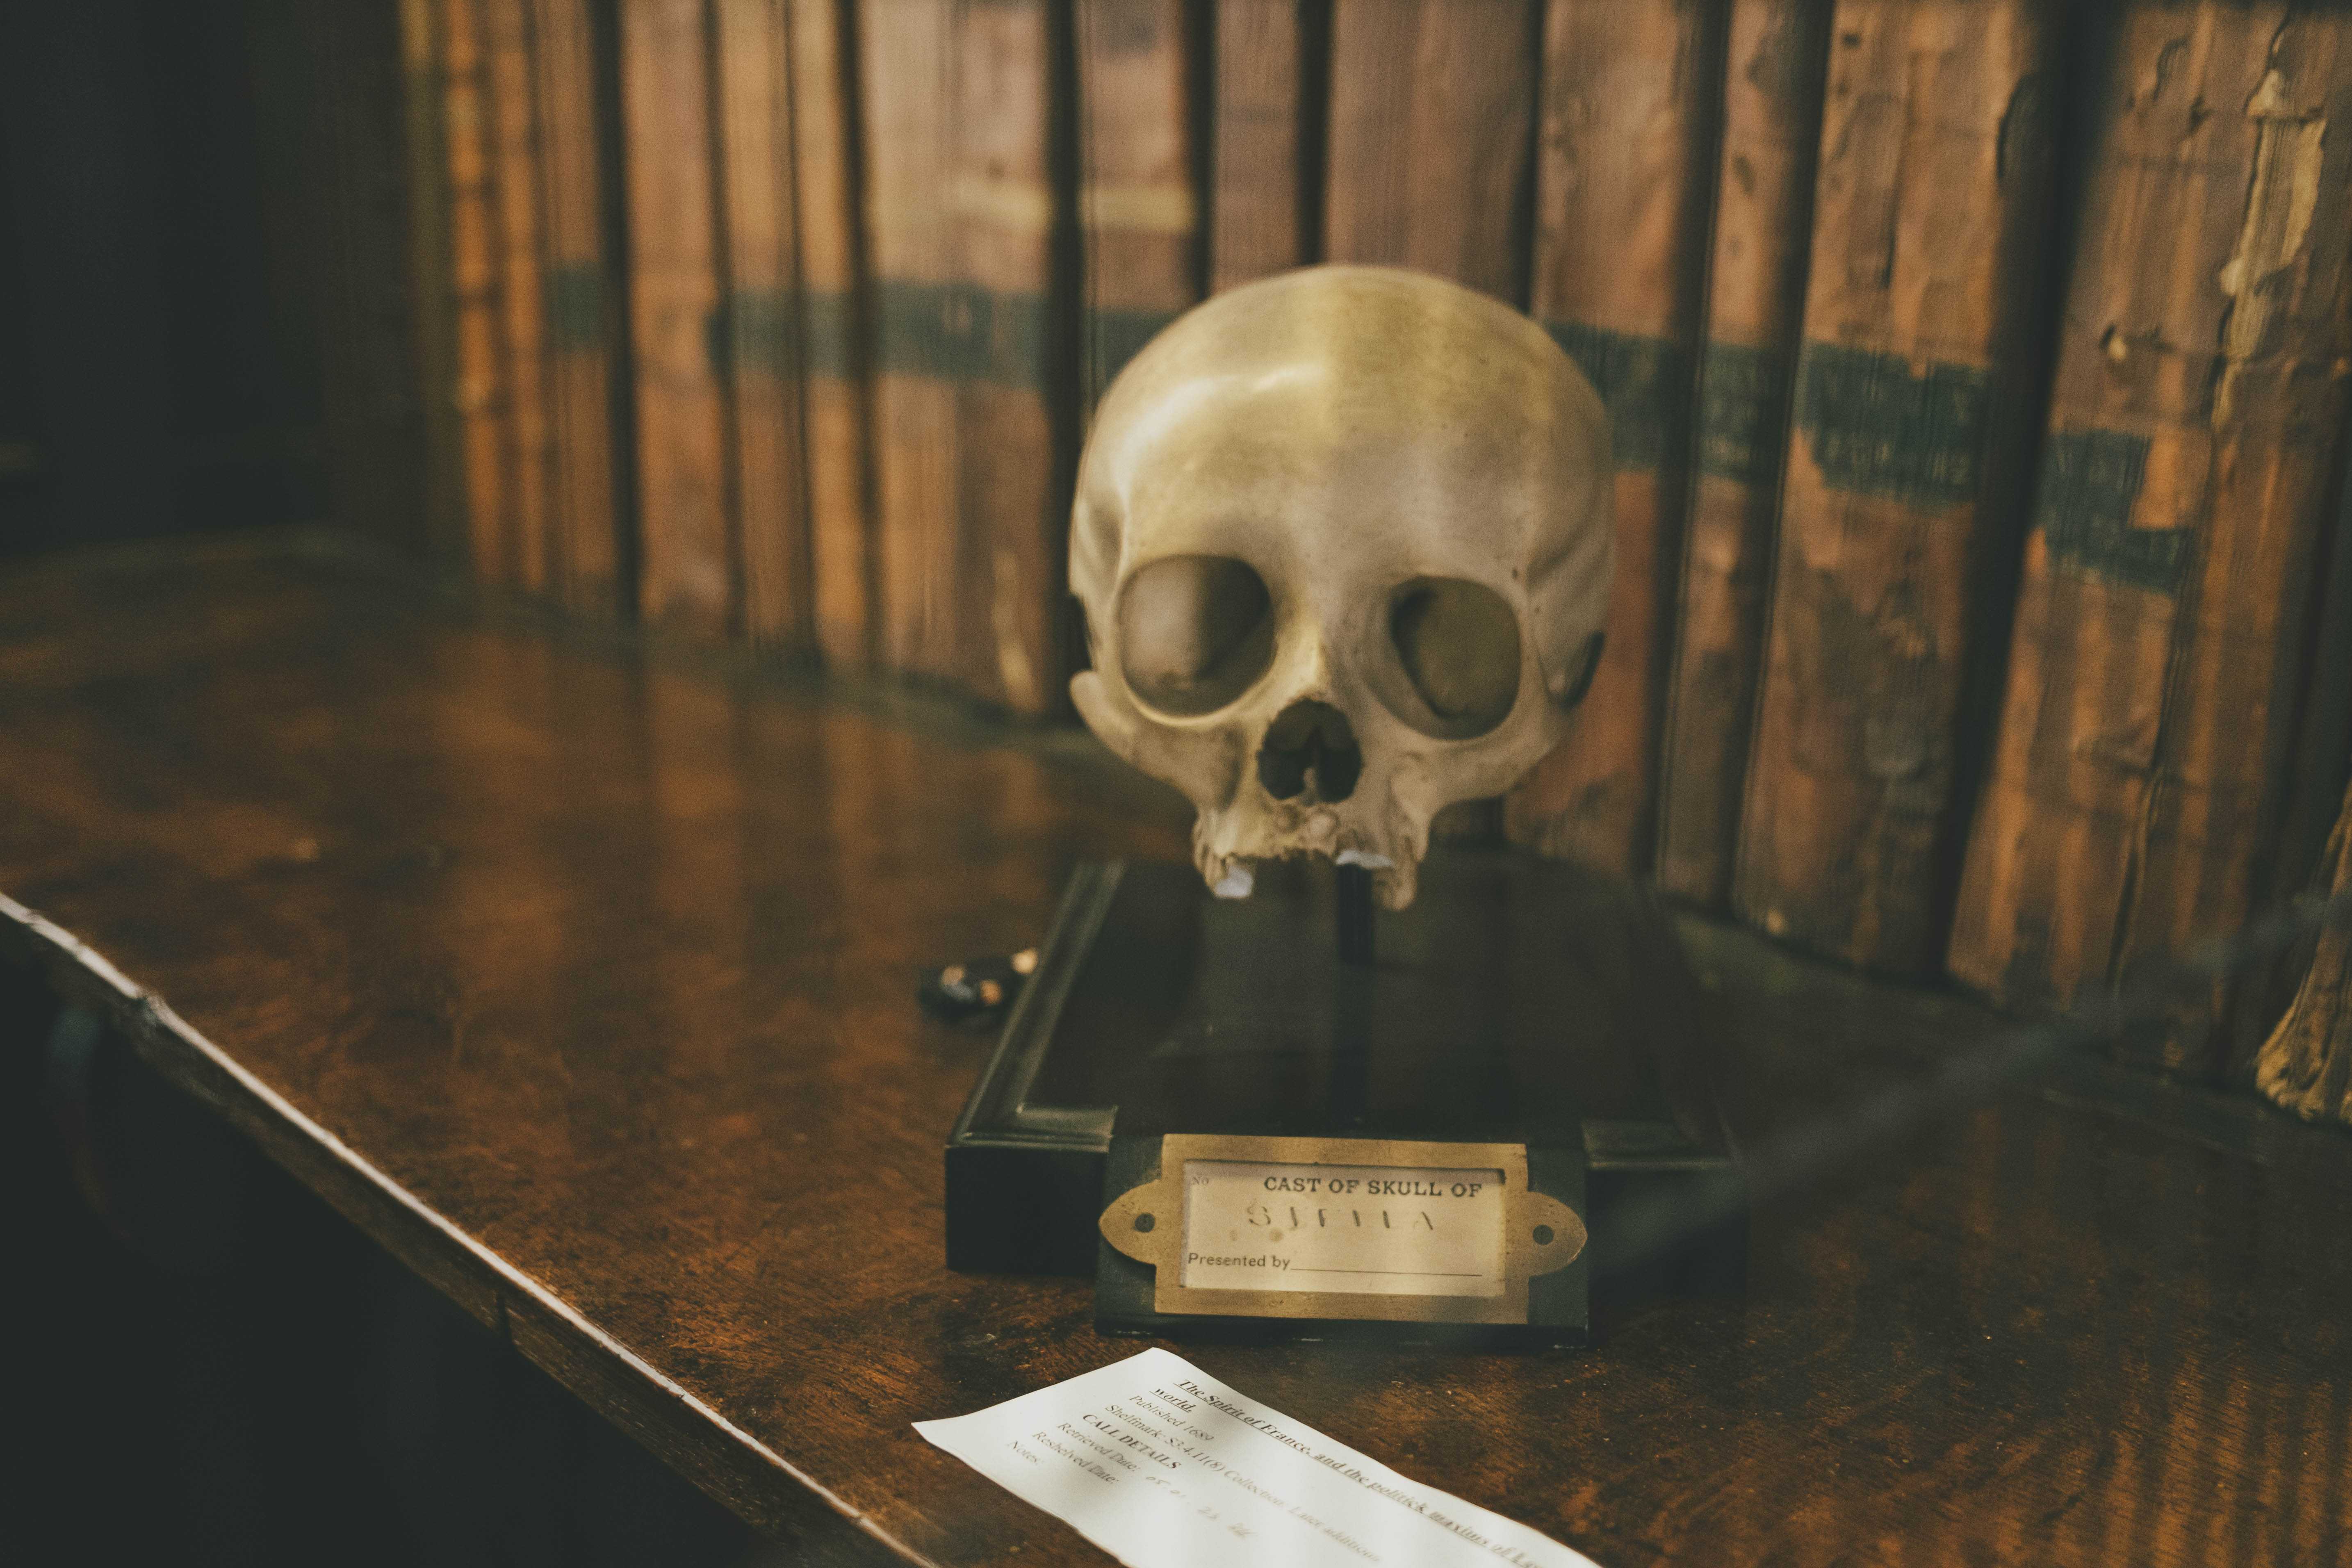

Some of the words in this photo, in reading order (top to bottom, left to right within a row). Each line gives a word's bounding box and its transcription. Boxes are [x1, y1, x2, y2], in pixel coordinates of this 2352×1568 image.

[1264, 1176, 1321, 1192] CAST
[1329, 1178, 1360, 1194] OF
[1367, 1180, 1442, 1197] SKULL
[1450, 1183, 1482, 1197] OF
[1188, 1253, 1266, 1267] Presented
[1272, 1255, 1291, 1270] by
[1129, 1395, 1186, 1427] Published
[1154, 1388, 1196, 1412] world.
[1105, 1404, 1166, 1439] Shelfmark:
[1032, 1431, 1093, 1468] Reshelved
[1087, 1464, 1119, 1484] Date:
[1056, 1422, 1113, 1455] Retrieved
[1110, 1453, 1141, 1472] Date:
[1083, 1414, 1120, 1437] CALL
[1118, 1435, 1182, 1469] DETAILS
[1180, 1379, 1205, 1395] The
[1204, 1395, 1245, 1416] Spirit
[1244, 1416, 1265, 1425] of
[1315, 1454, 1347, 1469] and
[1344, 1468, 1369, 1483] the
[1366, 1482, 1428, 1513] politick
[1429, 1511, 1489, 1544] maxims
[1491, 1544, 1517, 1556] of
